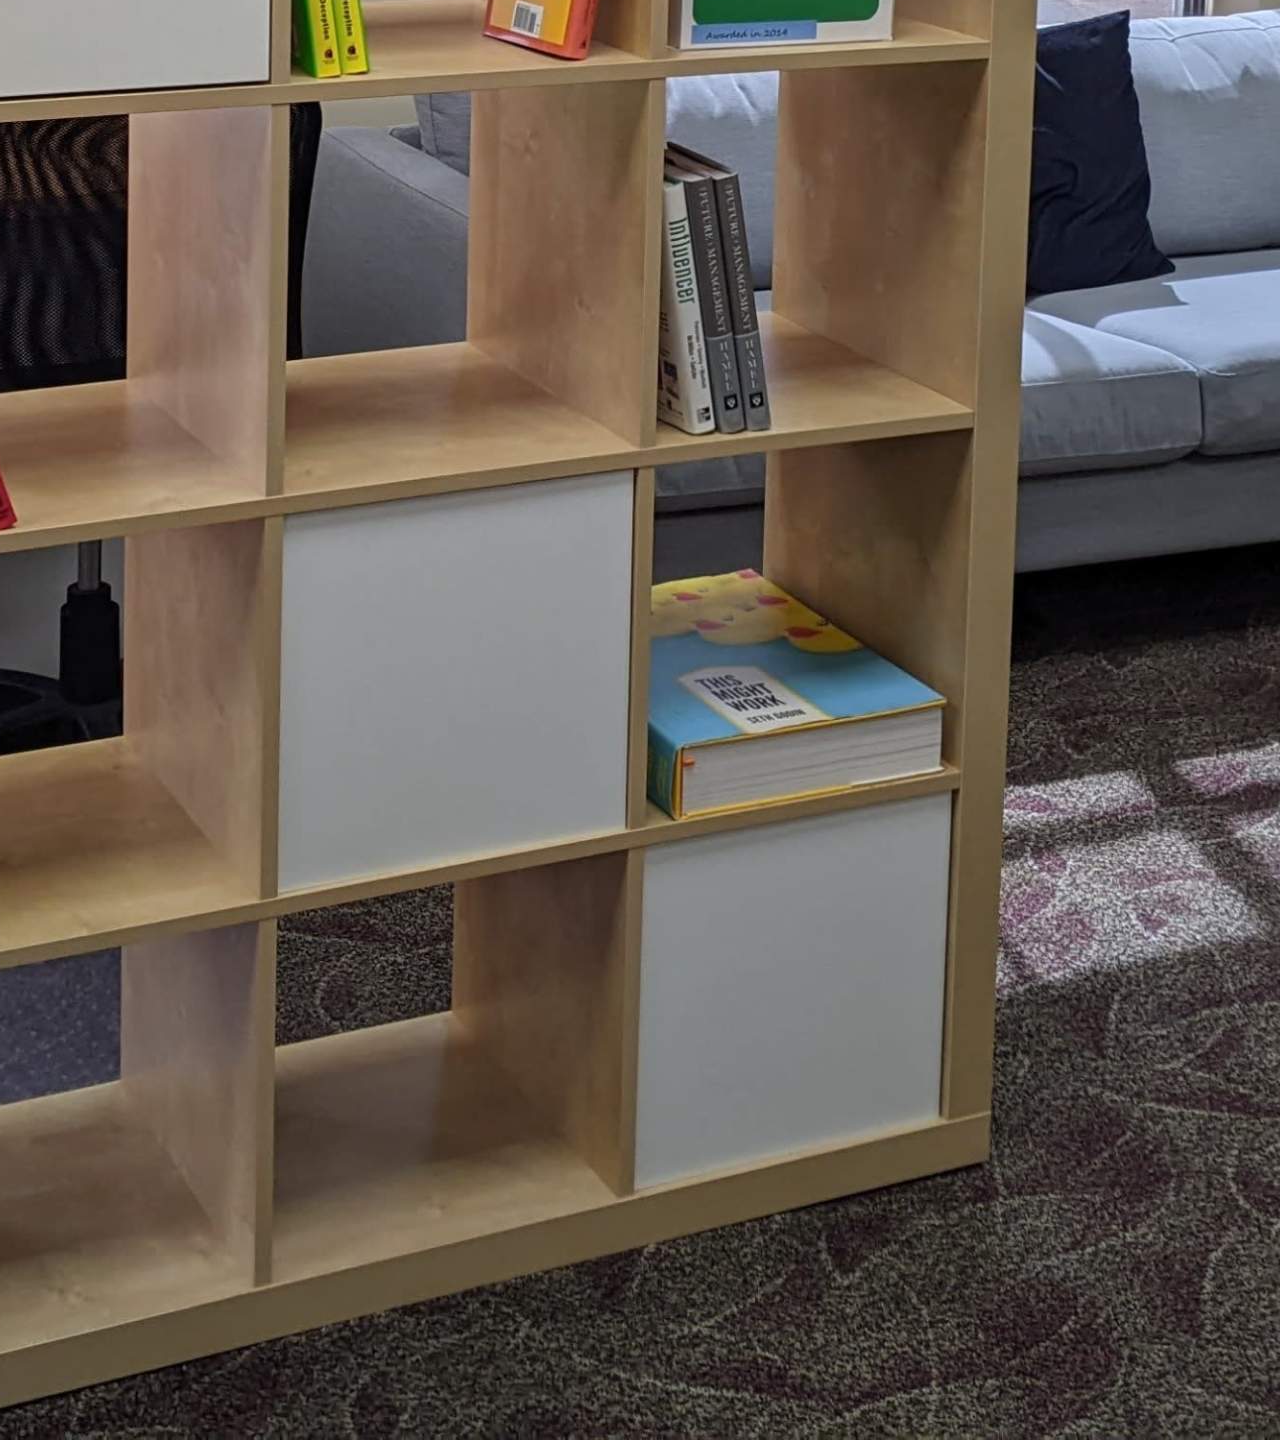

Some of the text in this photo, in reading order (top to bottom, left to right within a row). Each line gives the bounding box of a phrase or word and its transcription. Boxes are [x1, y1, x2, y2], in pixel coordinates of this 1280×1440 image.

[705, 29, 747, 40] Awarded
[750, 28, 762, 38] in
[668, 217, 695, 305] Influencer
[700, 192, 726, 333] FUTURE MANAGEMENT
[725, 190, 751, 331] FUTURE MANAGEMENT
[694, 674, 743, 690] THIS
[711, 682, 773, 701] MIGHT
[725, 694, 786, 712] WORK
[747, 714, 775, 724] SETH
